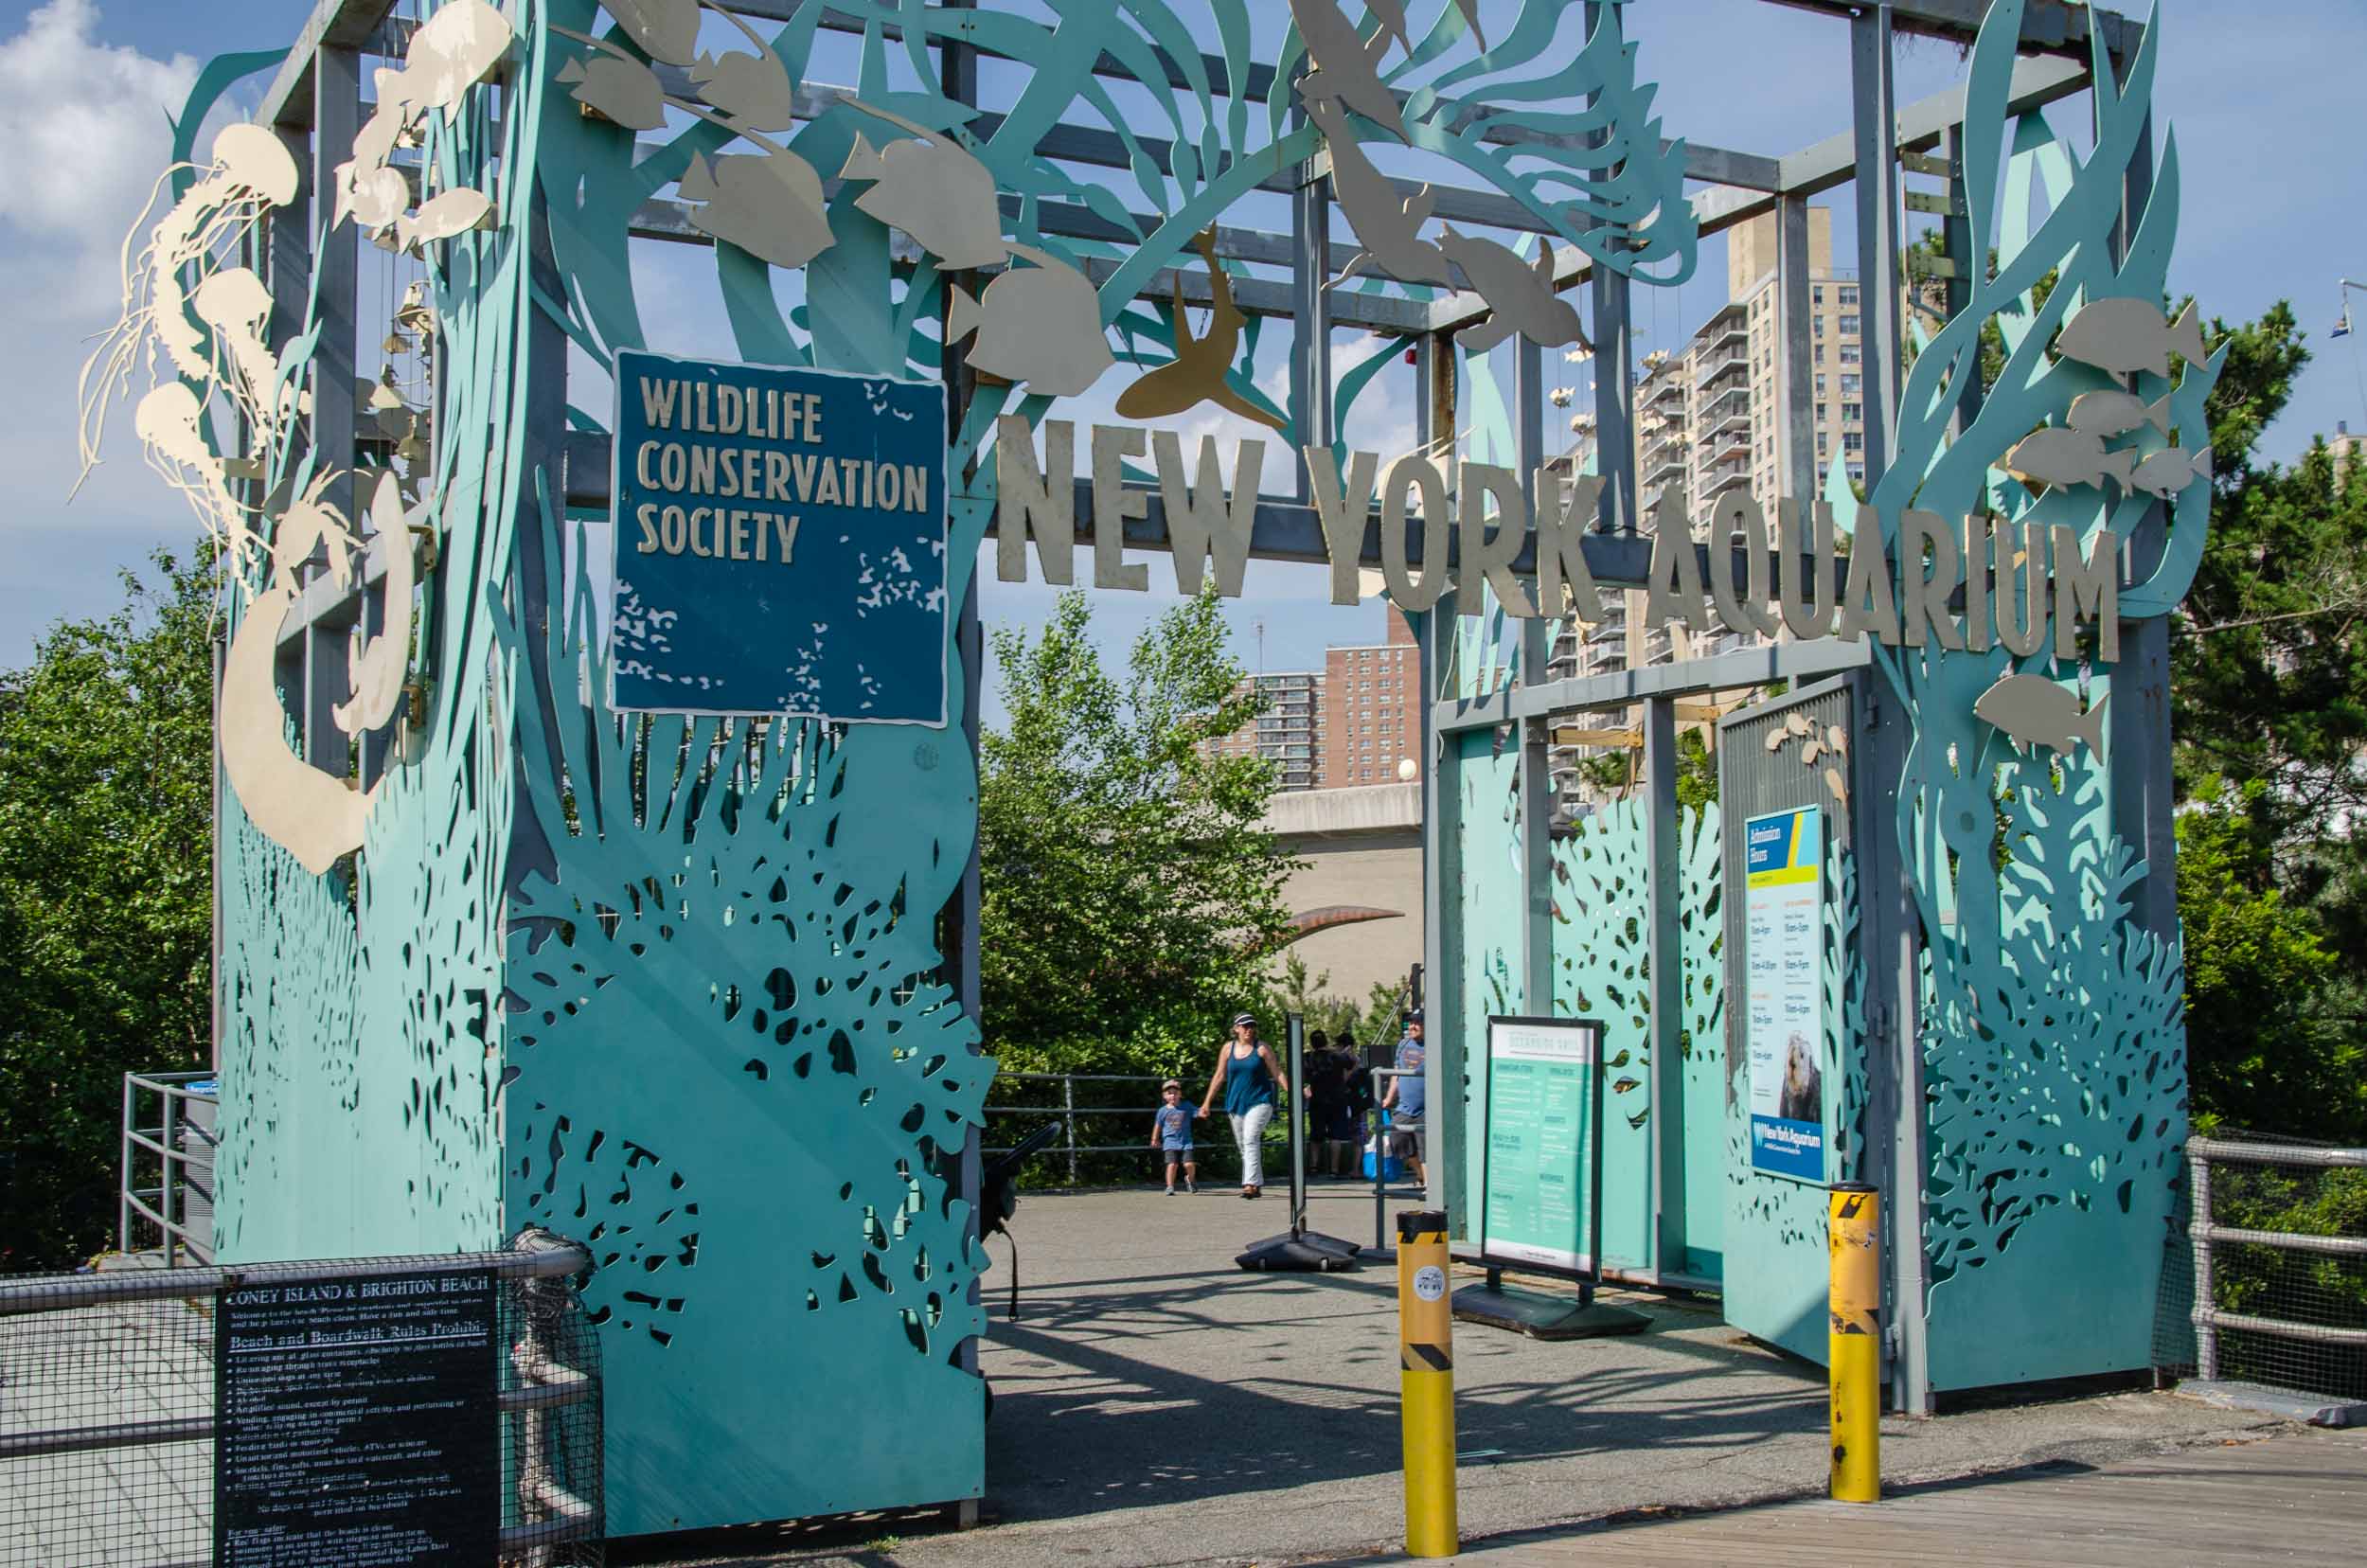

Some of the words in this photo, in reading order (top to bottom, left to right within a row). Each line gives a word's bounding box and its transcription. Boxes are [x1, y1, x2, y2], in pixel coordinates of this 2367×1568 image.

[638, 376, 824, 444] WILDLIFE
[635, 439, 929, 513] CONSERVATION
[635, 503, 801, 564] SOCIETY
[996, 414, 1266, 598] NEW
[1303, 444, 1608, 623] YORK
[1644, 480, 2121, 663] AQUARIUM
[1764, 1123, 1776, 1140] New
[1776, 1125, 1789, 1142] York
[1789, 1128, 1821, 1149] Aquarium
[225, 1288, 280, 1305] CONEY
[284, 1285, 342, 1303] ISLAND
[346, 1284, 357, 1299] &
[363, 1279, 436, 1298] BRIGHTON
[439, 1275, 489, 1293] BEACH
[230, 1334, 274, 1349] Beach
[279, 1333, 305, 1345] and
[311, 1327, 383, 1345] Boardwalk
[392, 1325, 427, 1339] Rules
